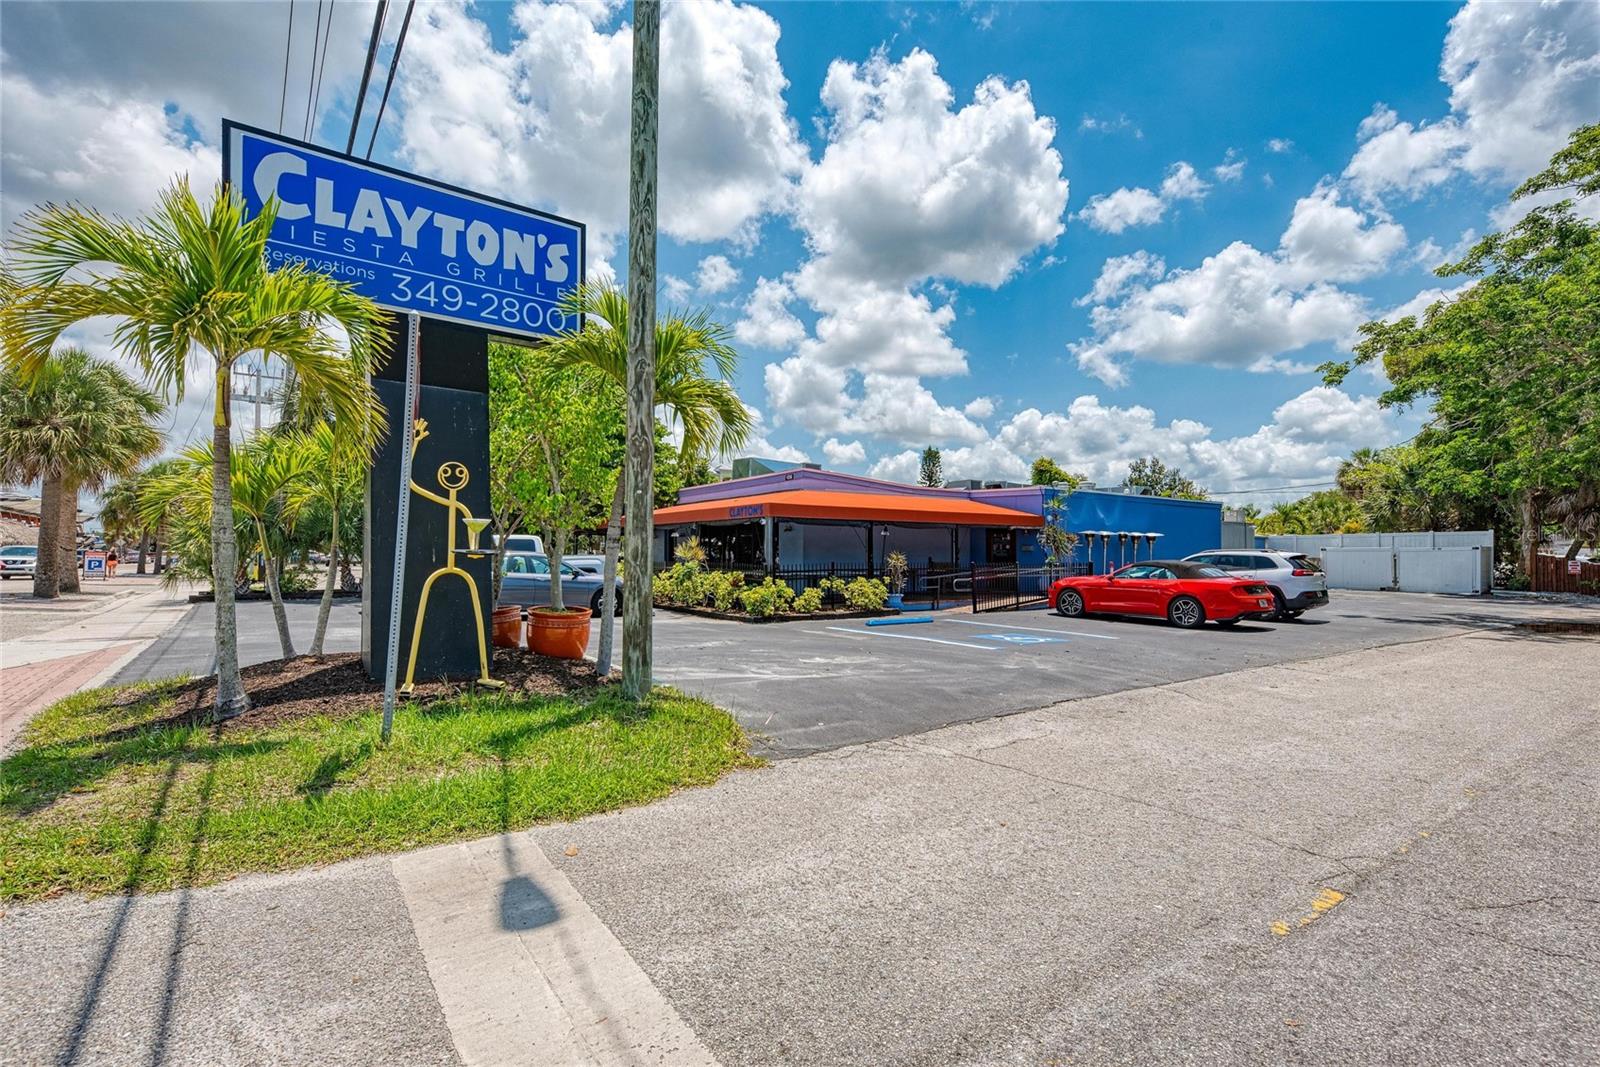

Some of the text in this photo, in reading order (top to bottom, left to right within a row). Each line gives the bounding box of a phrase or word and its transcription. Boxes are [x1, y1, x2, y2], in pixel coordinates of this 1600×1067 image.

[253, 151, 570, 283] CLAYTON'S
[263, 246, 376, 281] Reservations
[268, 224, 567, 300] IESTA GRILLE
[390, 273, 566, 333] 349-2800
